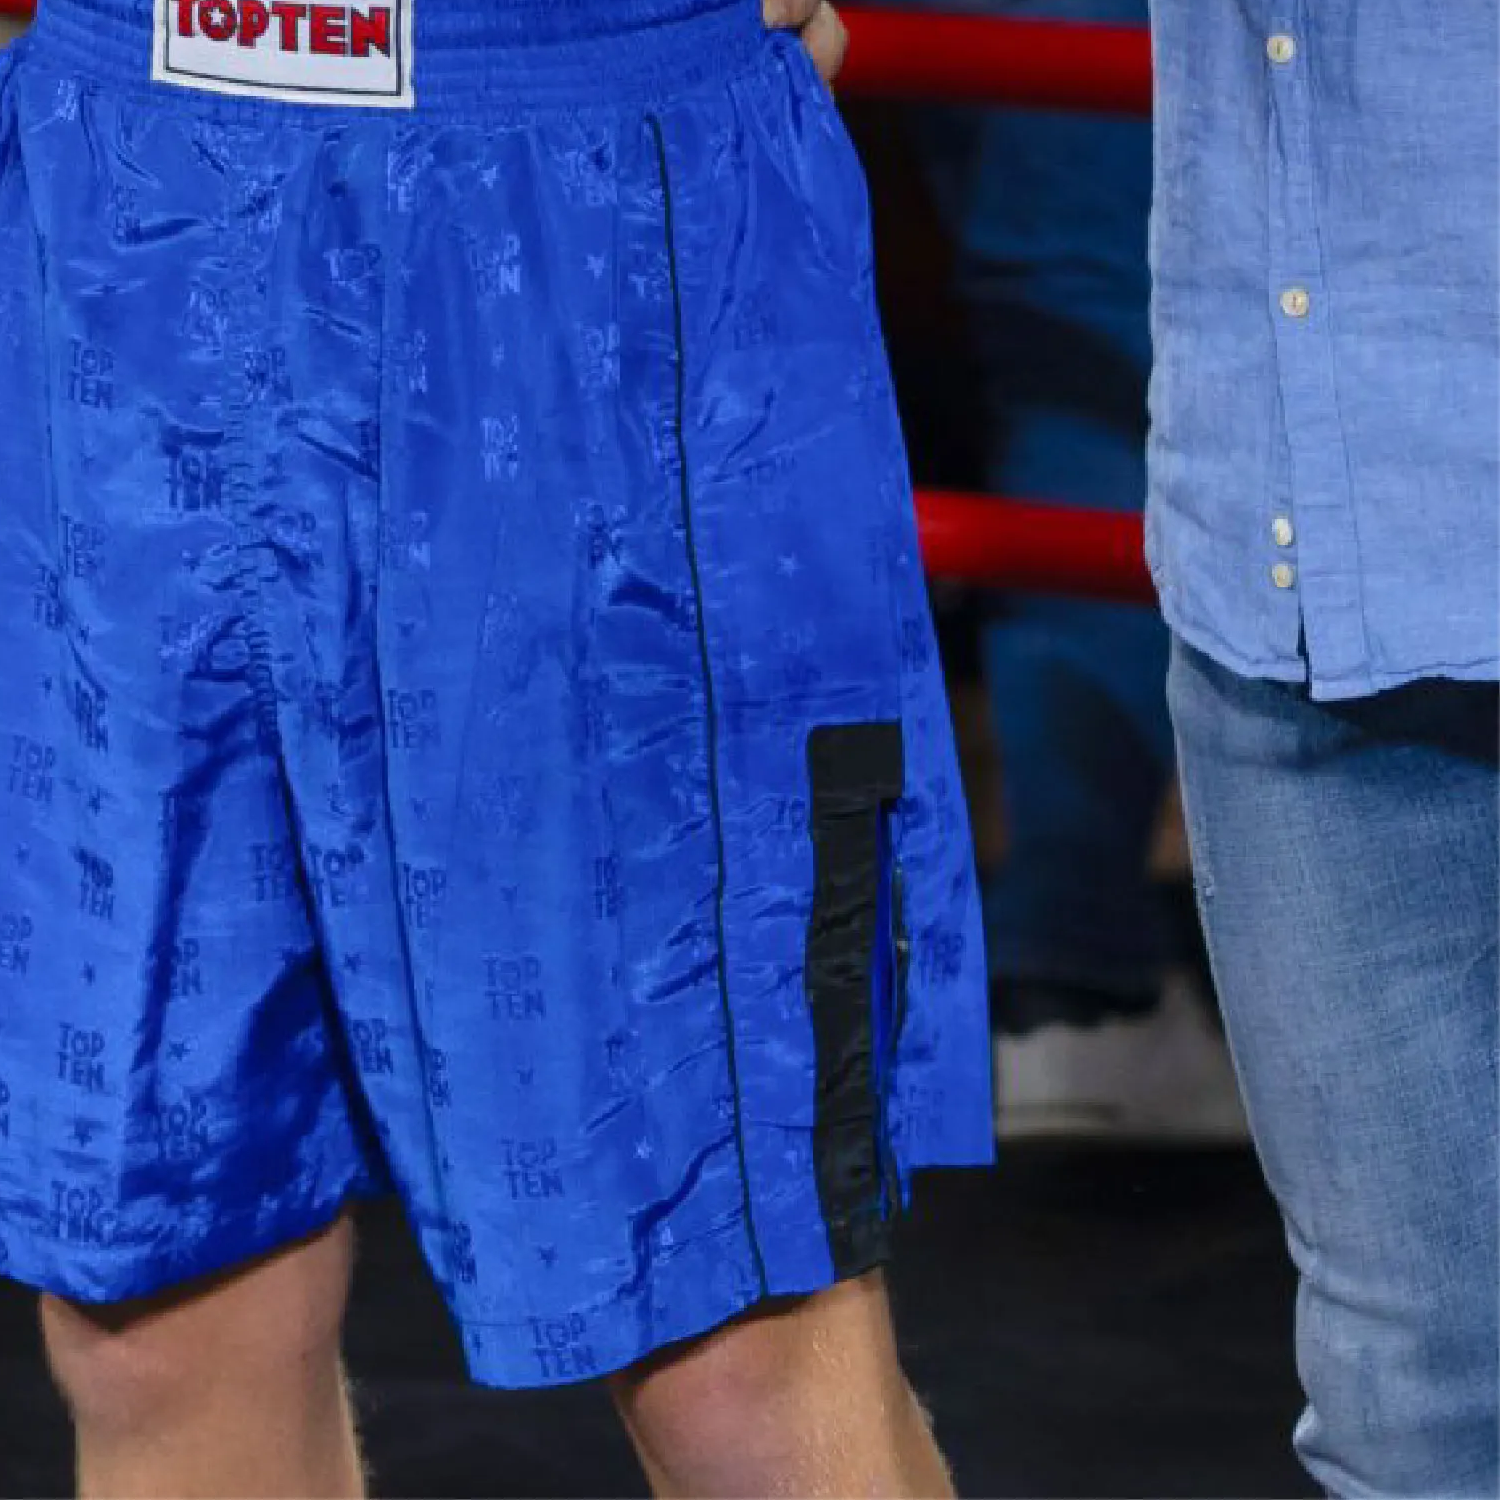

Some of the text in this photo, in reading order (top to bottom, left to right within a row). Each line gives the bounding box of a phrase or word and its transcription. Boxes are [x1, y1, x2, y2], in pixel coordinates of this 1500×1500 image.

[69, 339, 115, 375] TOP
[11, 734, 55, 769] TOP
[404, 863, 446, 898] TOP
[58, 1022, 106, 1058] TOP
[57, 1051, 106, 1094] TEN
[503, 1167, 566, 1200] TEN
